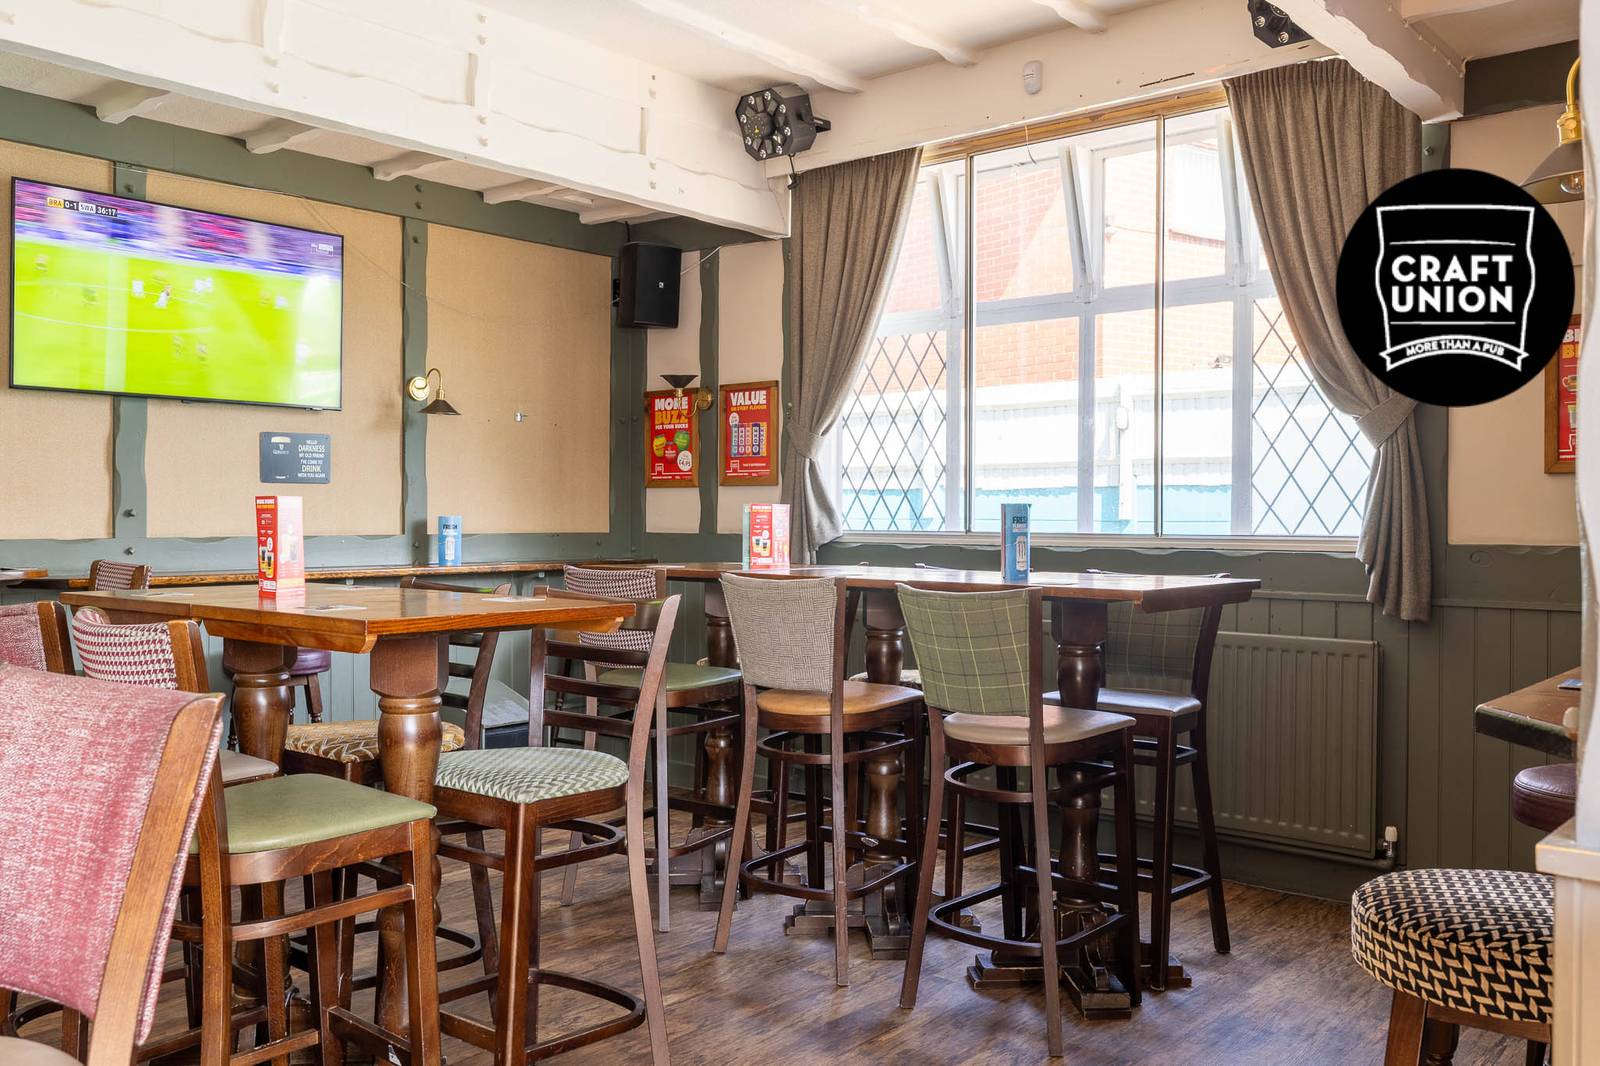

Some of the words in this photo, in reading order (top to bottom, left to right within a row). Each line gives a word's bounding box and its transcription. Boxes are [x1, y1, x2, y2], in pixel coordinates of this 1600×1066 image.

[48, 198, 62, 207] BRA
[97, 206, 117, 216] 36:17
[730, 390, 767, 406] VALUE
[655, 410, 688, 425] BUZZ
[299, 445, 325, 453] DARKNESS
[302, 464, 321, 472] DRINK
